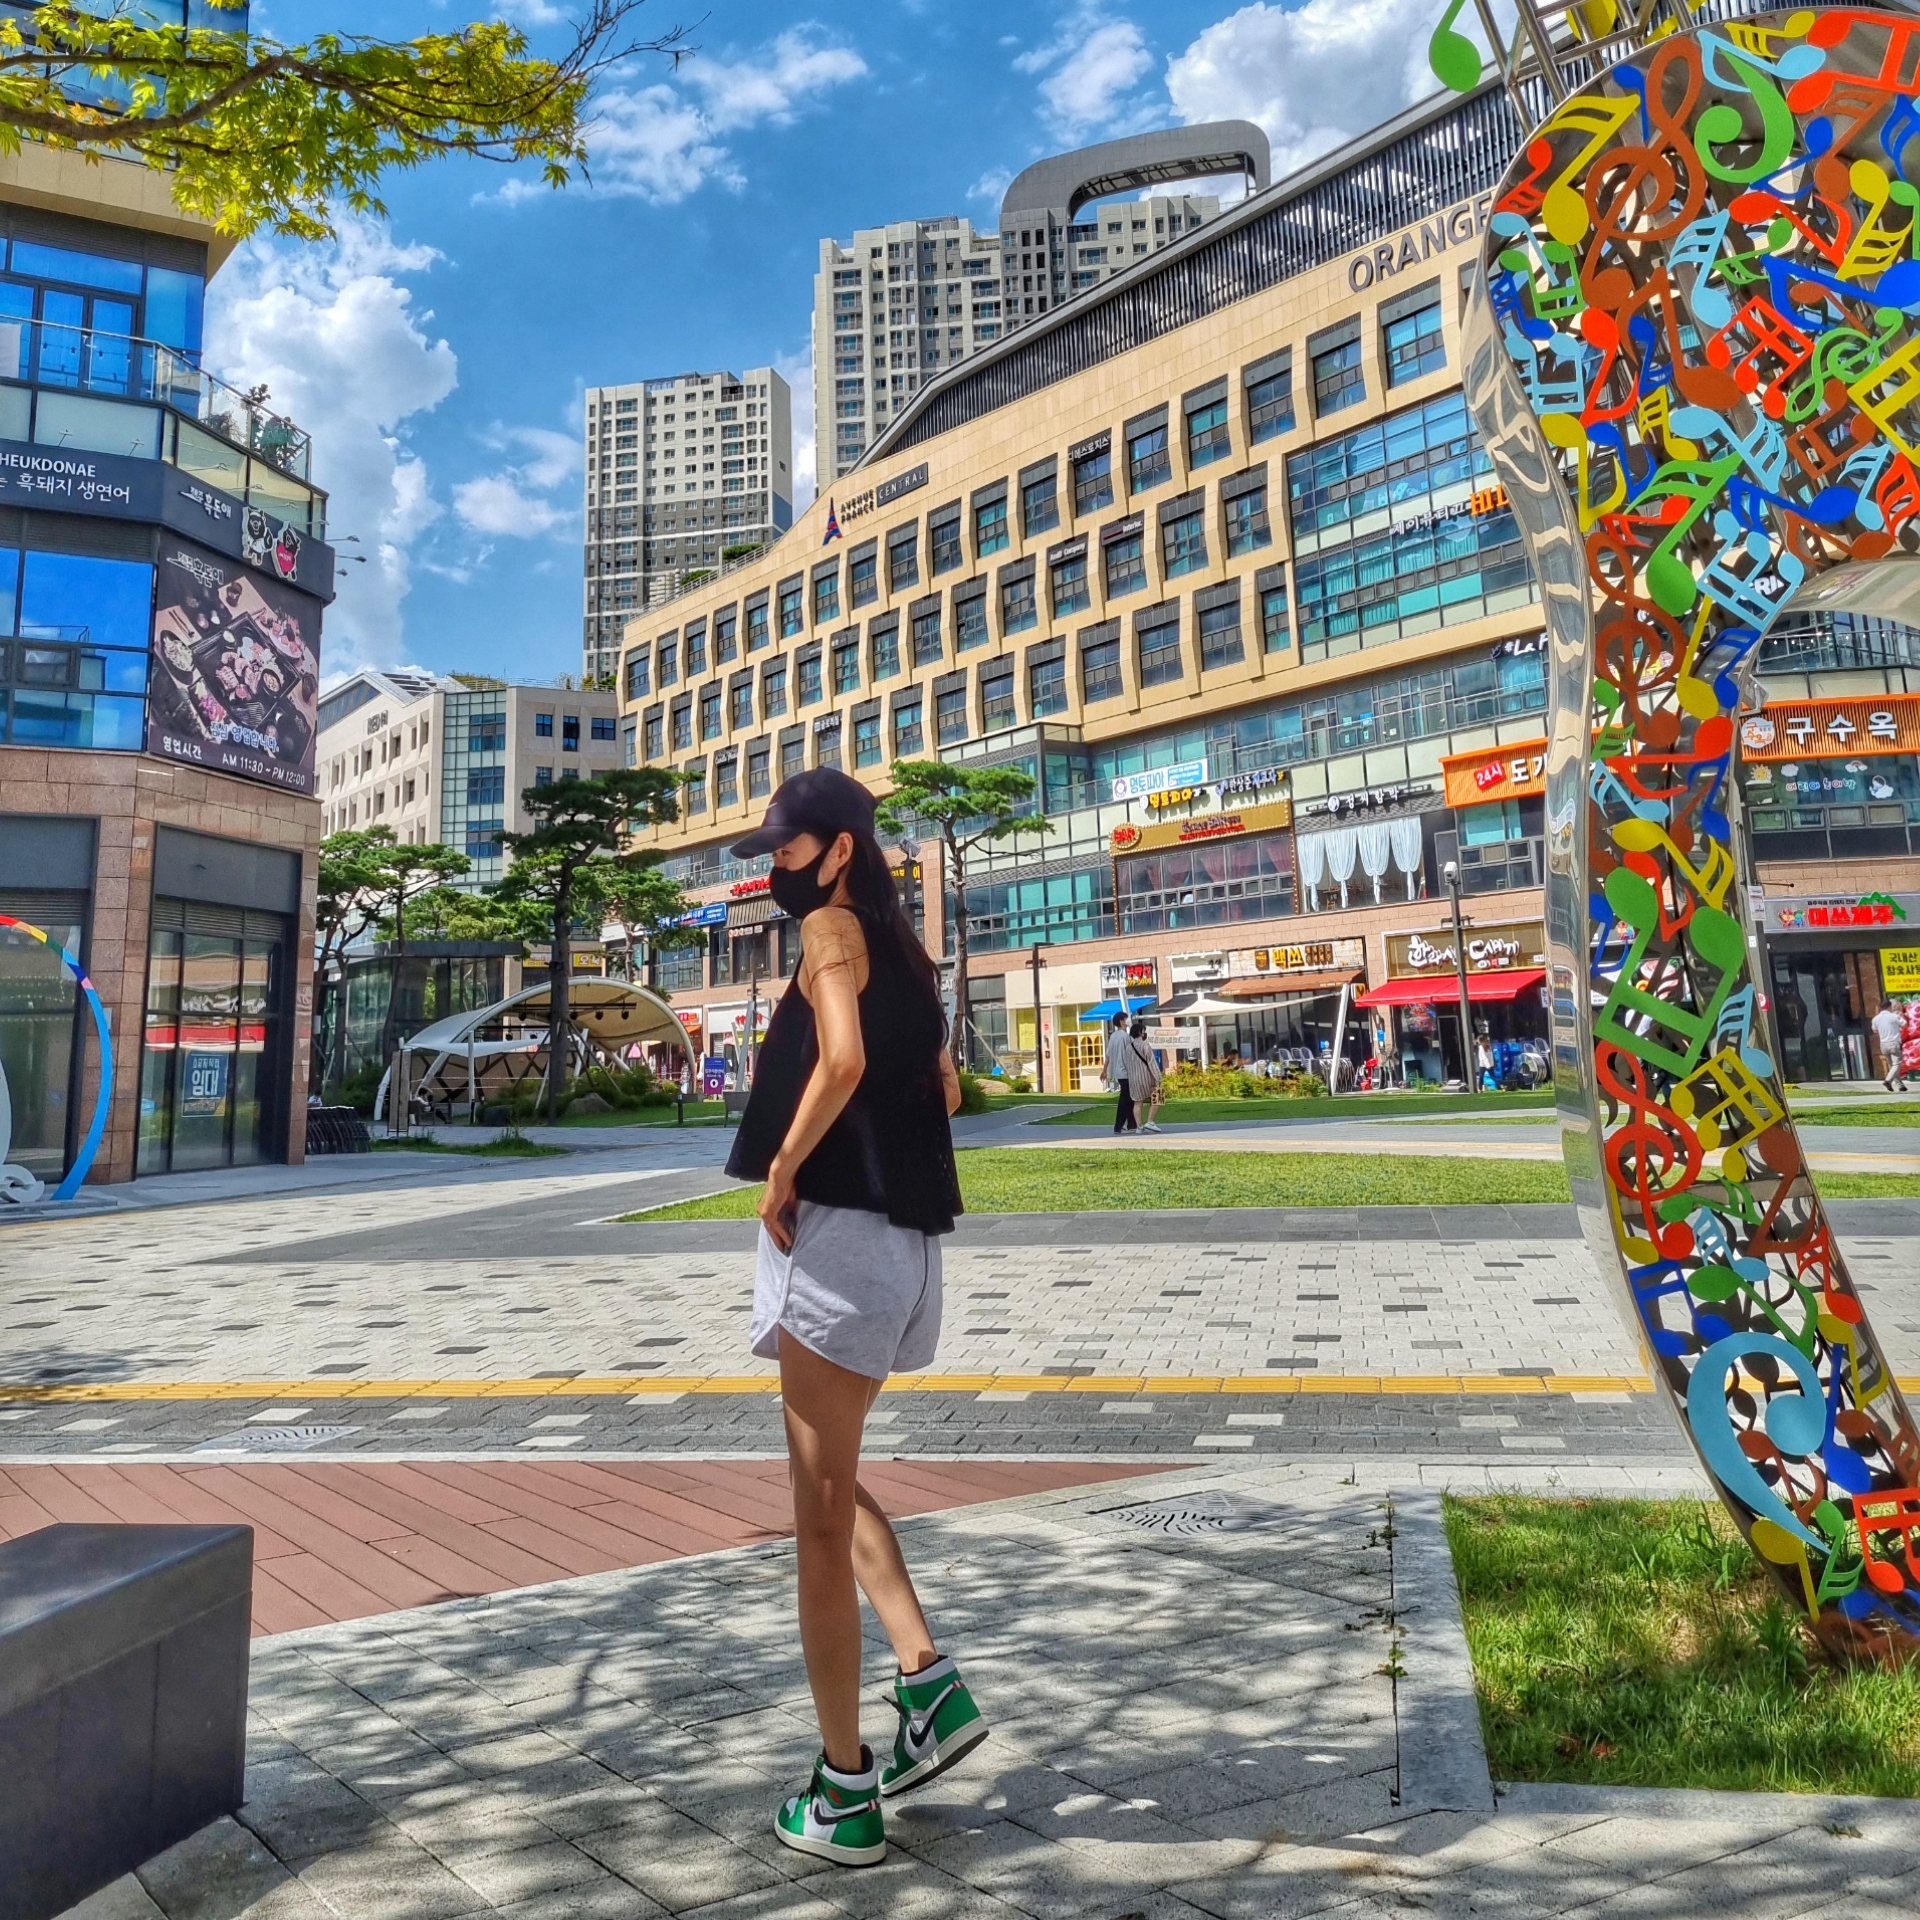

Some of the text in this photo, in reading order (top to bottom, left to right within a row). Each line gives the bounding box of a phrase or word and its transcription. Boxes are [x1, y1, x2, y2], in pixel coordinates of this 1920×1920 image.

[1349, 192, 1491, 292] ORANGE
[0, 452, 96, 478] HEUKDONAE
[16, 472, 72, 496] 흑돼지
[77, 481, 130, 504] 생연어
[879, 470, 924, 499] CENTRAL
[841, 489, 874, 513] AVENUE
[210, 722, 229, 741] 점심
[1786, 711, 1898, 745] 구수옥
[162, 736, 203, 760] 영업시간
[222, 753, 237, 767] AM
[240, 757, 263, 774] 11:30
[272, 768, 284, 781] PM
[285, 770, 305, 786] 12:00
[1476, 762, 1503, 786] 24시
[1129, 770, 1165, 795] 멍토피아
[1149, 788, 1192, 809] 멍토피아
[1889, 952, 1918, 963] 국내산
[192, 1070, 219, 1096] 임대
